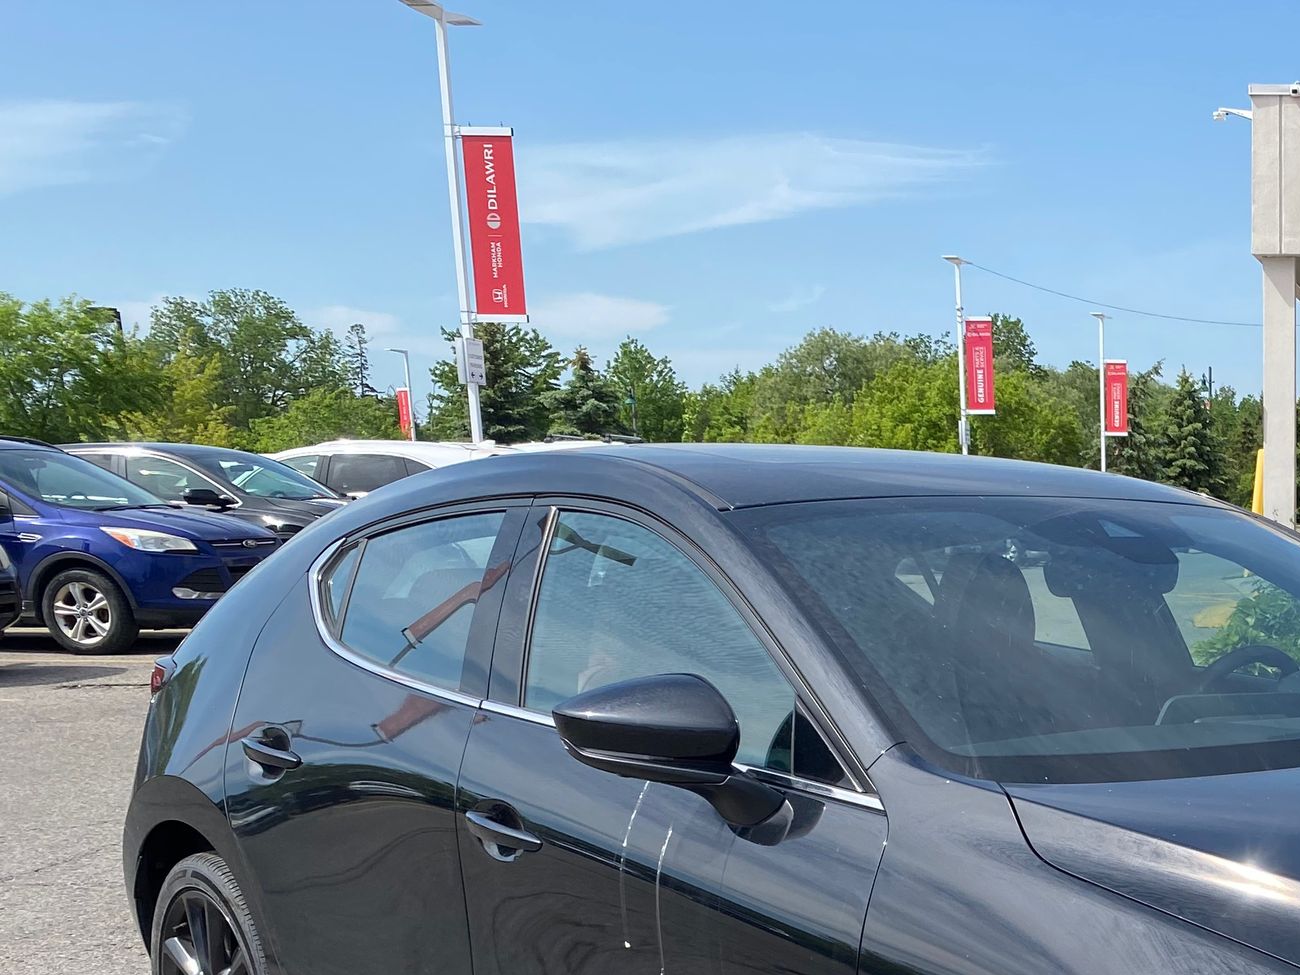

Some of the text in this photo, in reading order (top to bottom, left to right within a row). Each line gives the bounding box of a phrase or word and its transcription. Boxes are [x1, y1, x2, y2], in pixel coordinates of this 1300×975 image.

[483, 144, 498, 209] DILAWRI
[490, 242, 498, 278] MARKHAM
[976, 369, 985, 403] GENUINE
